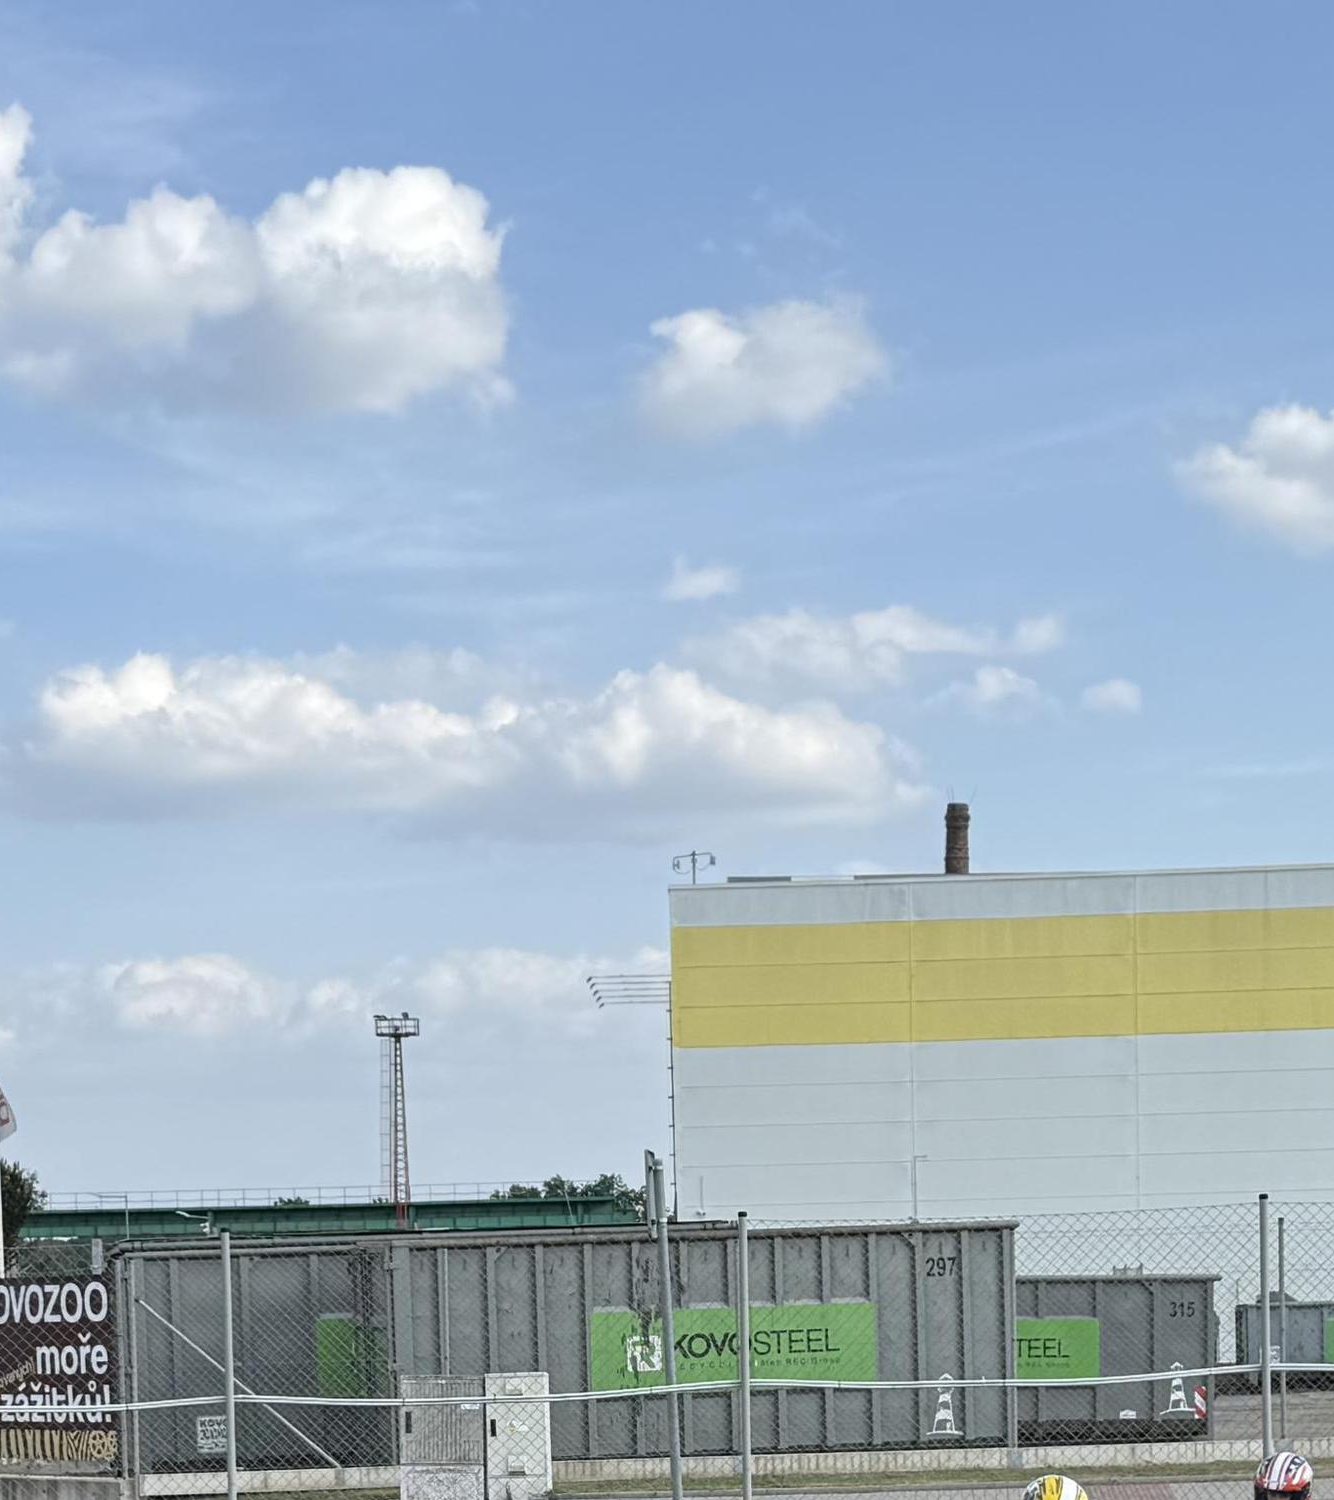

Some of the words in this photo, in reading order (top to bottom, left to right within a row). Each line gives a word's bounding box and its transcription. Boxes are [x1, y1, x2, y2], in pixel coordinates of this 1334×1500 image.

[926, 1257, 956, 1277] 297
[1169, 1302, 1196, 1317] 315
[36, 1332, 108, 1375] moře
[0, 1380, 113, 1422] zážitků!
